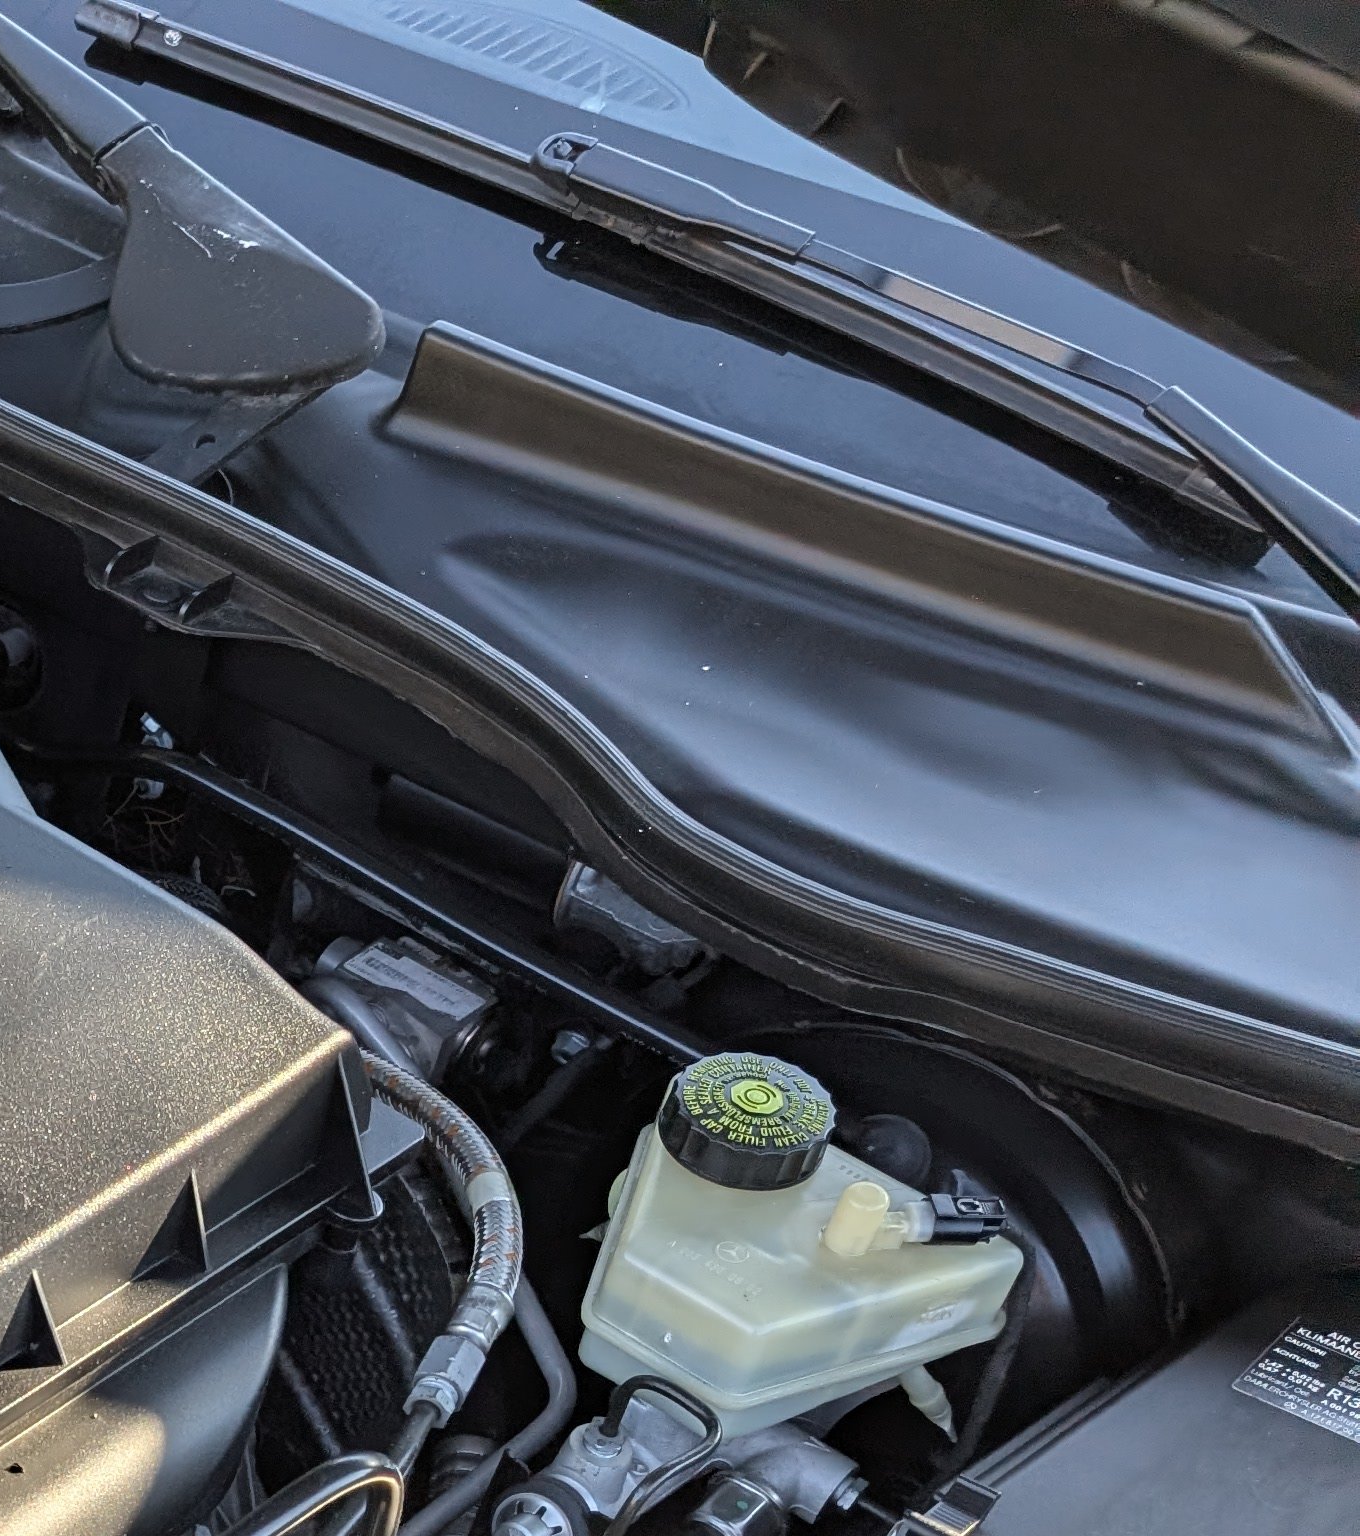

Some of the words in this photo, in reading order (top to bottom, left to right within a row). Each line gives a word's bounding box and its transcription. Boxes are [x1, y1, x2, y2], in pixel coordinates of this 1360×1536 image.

[687, 1056, 736, 1082] REMOVING
[740, 1055, 763, 1066] USE
[708, 1064, 773, 1080] CONTAINER
[769, 1061, 797, 1078] ONLY
[683, 1084, 704, 1116] BEFORE
[698, 1079, 713, 1106] SEALED
[707, 1107, 720, 1115] A
[700, 1118, 723, 1134] CAP
[718, 1115, 753, 1134] FROM
[761, 1124, 793, 1137] FLUID
[728, 1130, 766, 1147] FILLER
[774, 1131, 809, 1148] CLEAN
[1284, 1336, 1327, 1357] CAUTION!
[1327, 1331, 1352, 1345] AIR
[1273, 1347, 1321, 1369] ACHTUNG!
[1243, 1375, 1322, 1412] DAIMLERCHRYSLER
